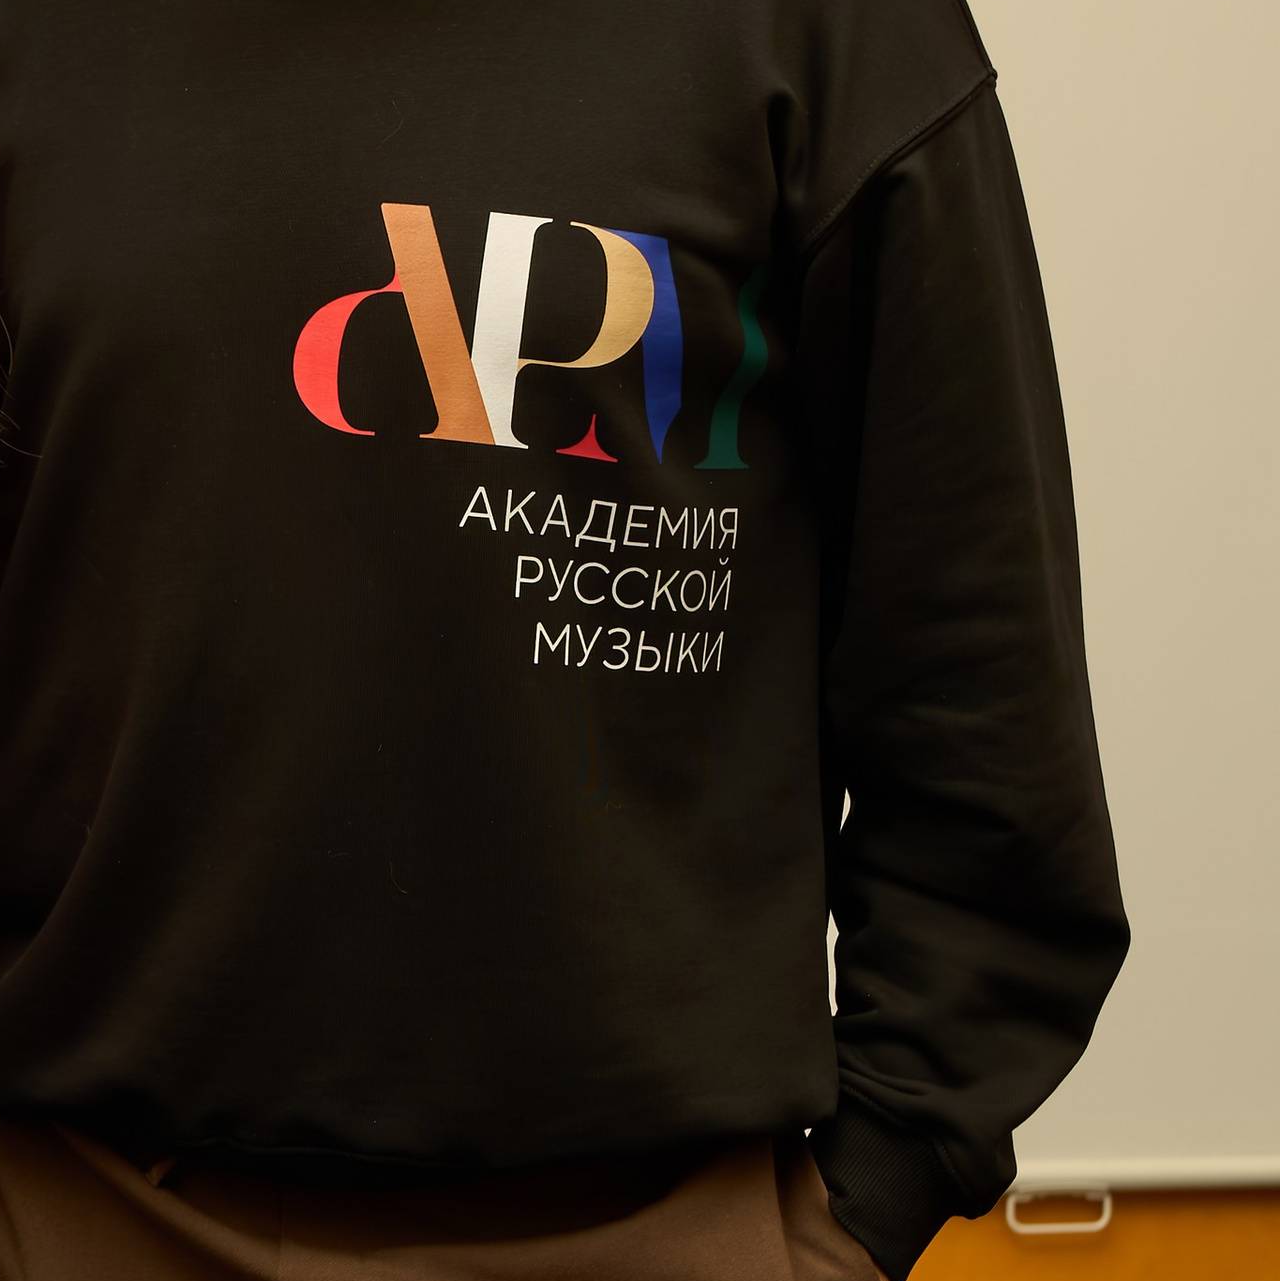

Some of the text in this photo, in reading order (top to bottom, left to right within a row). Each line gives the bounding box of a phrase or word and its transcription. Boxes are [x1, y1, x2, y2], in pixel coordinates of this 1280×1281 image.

[458, 485, 739, 553] АКАДЕМИЯ
[514, 555, 732, 612] РУССКОЙ
[533, 621, 724, 674] МУЗЫКИ
